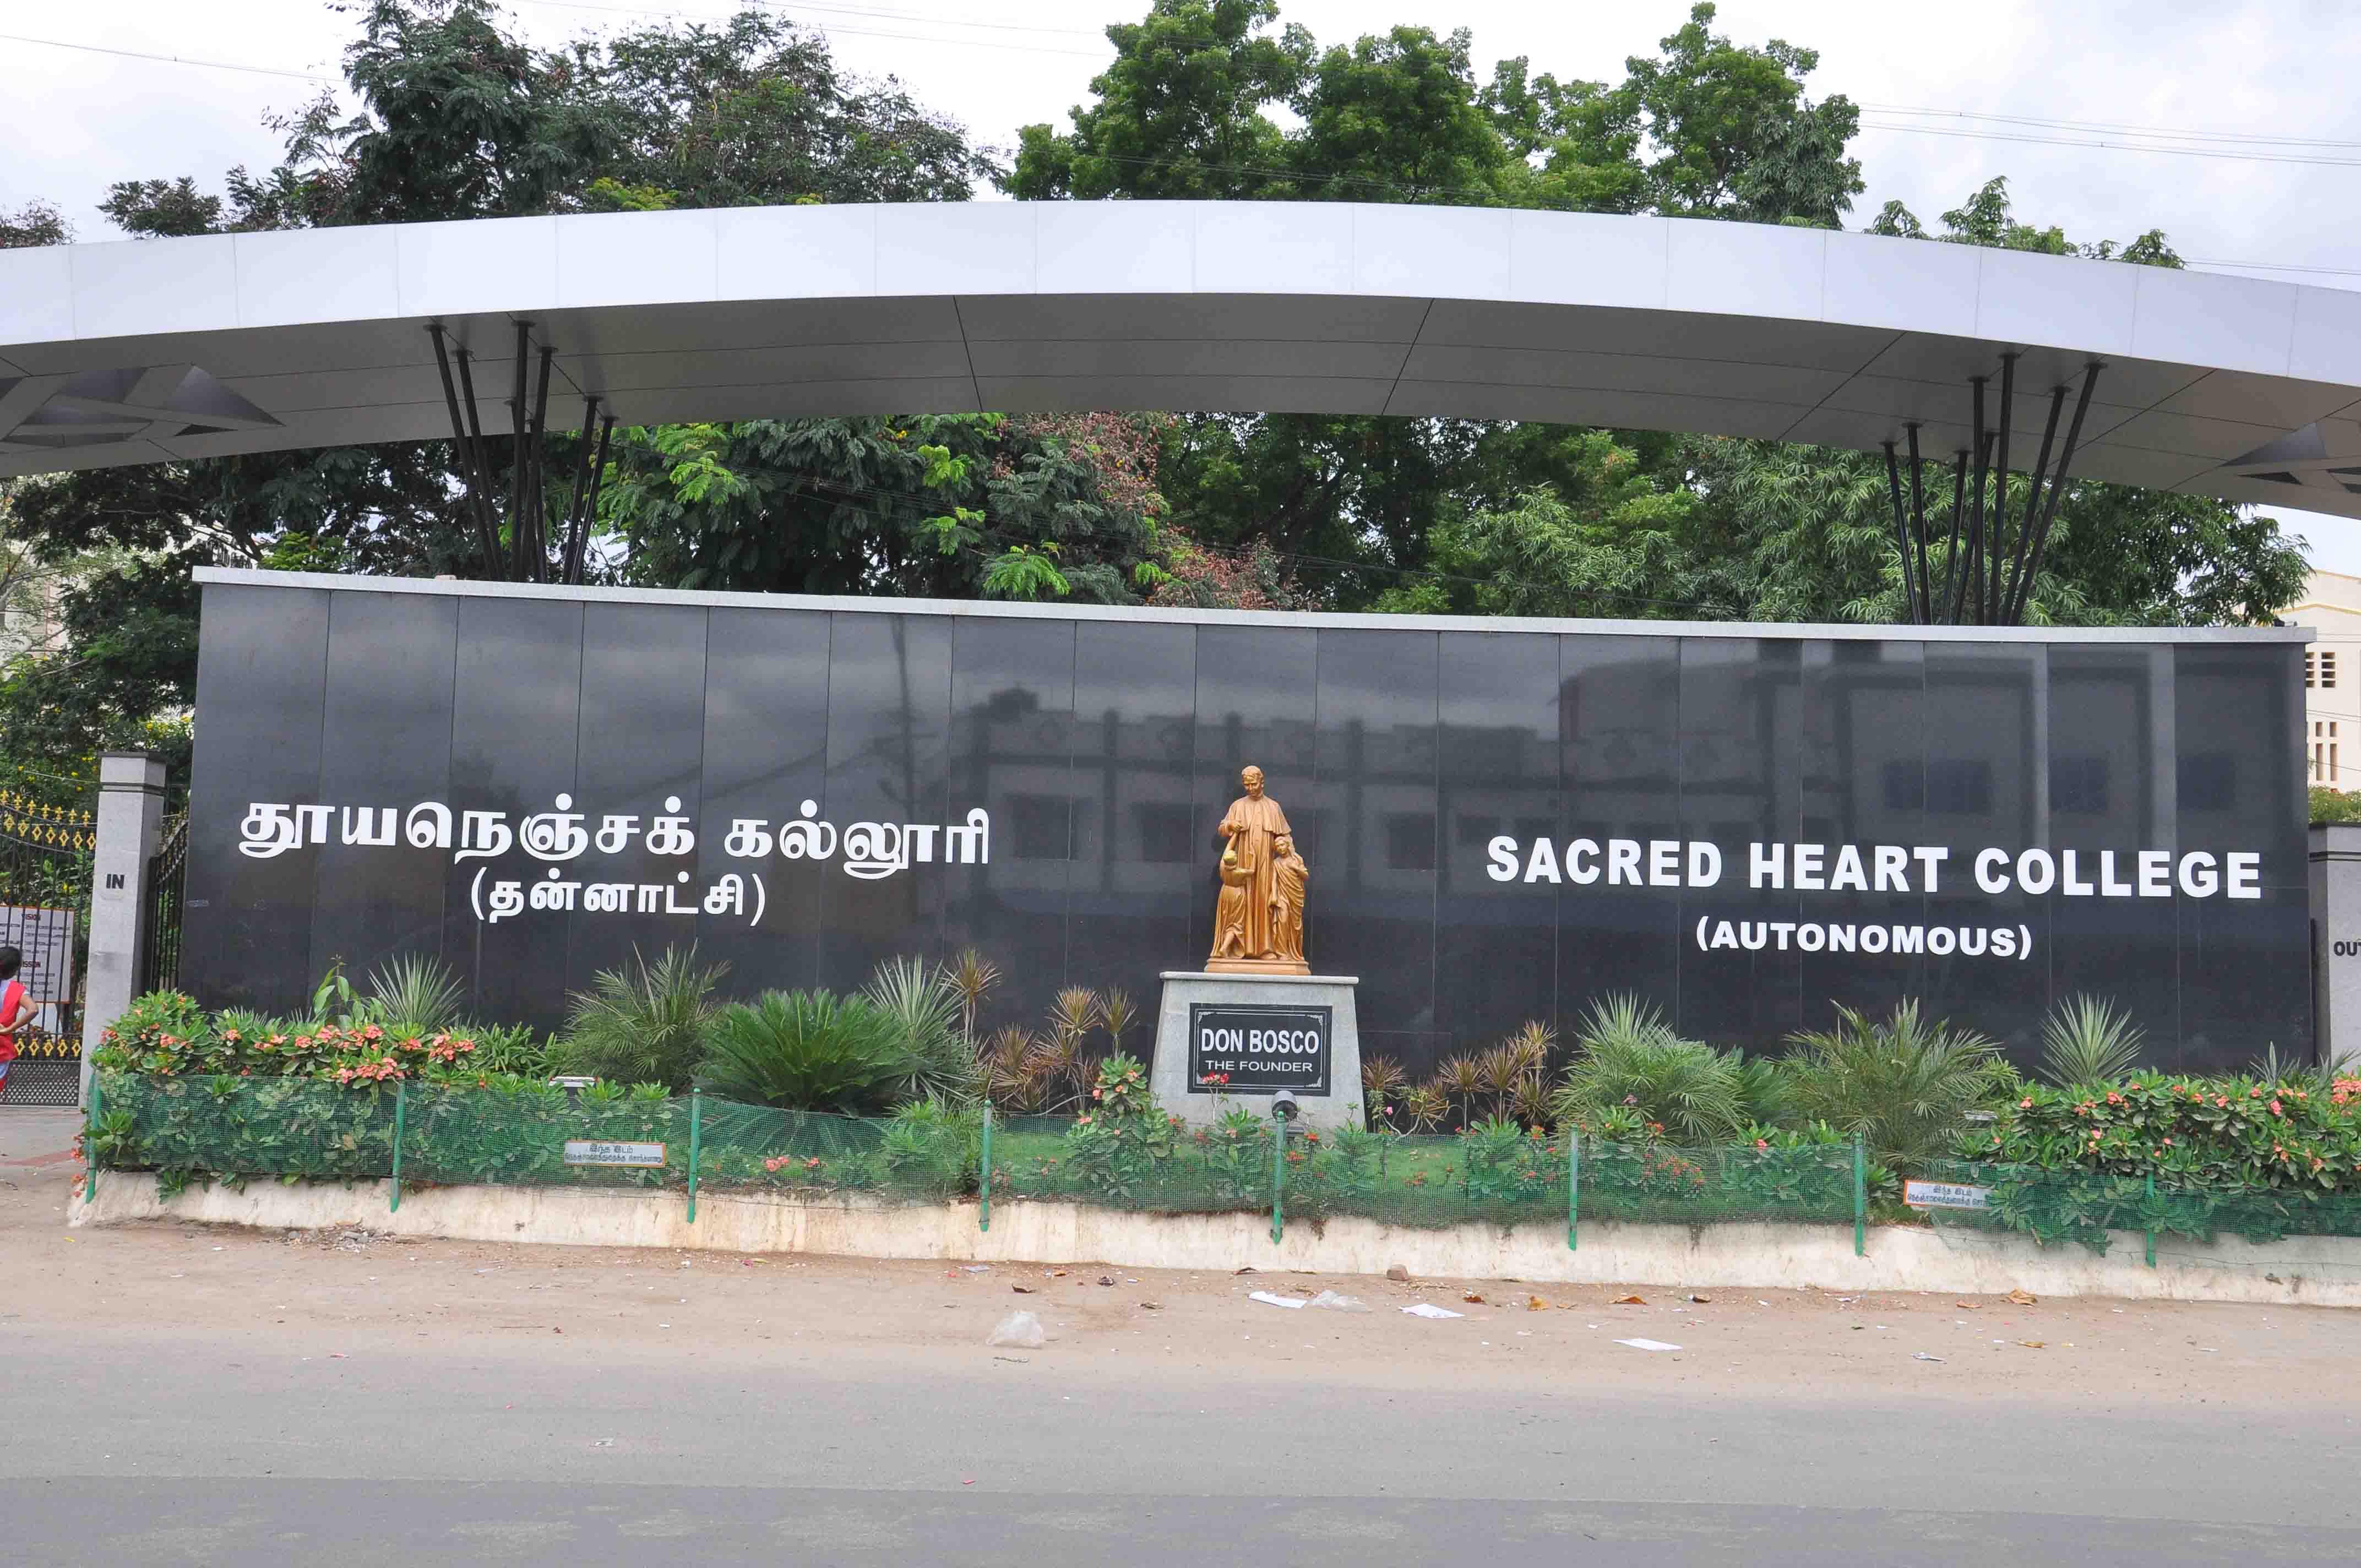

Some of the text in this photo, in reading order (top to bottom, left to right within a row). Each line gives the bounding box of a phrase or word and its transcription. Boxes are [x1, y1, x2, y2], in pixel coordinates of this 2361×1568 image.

[238, 793, 989, 880] தூயநெஞ்சக் கல்லூரி
[106, 874, 125, 889] IN
[1486, 836, 2261, 899] SACRED HEART COLLEGE
[471, 867, 766, 927] (தன்னாட்சி)
[1696, 915, 2032, 961] (AUTONOMOUS)
[1201, 1028, 1320, 1054] DON BOSCO
[1205, 1060, 1314, 1072] THE FOUNDER
